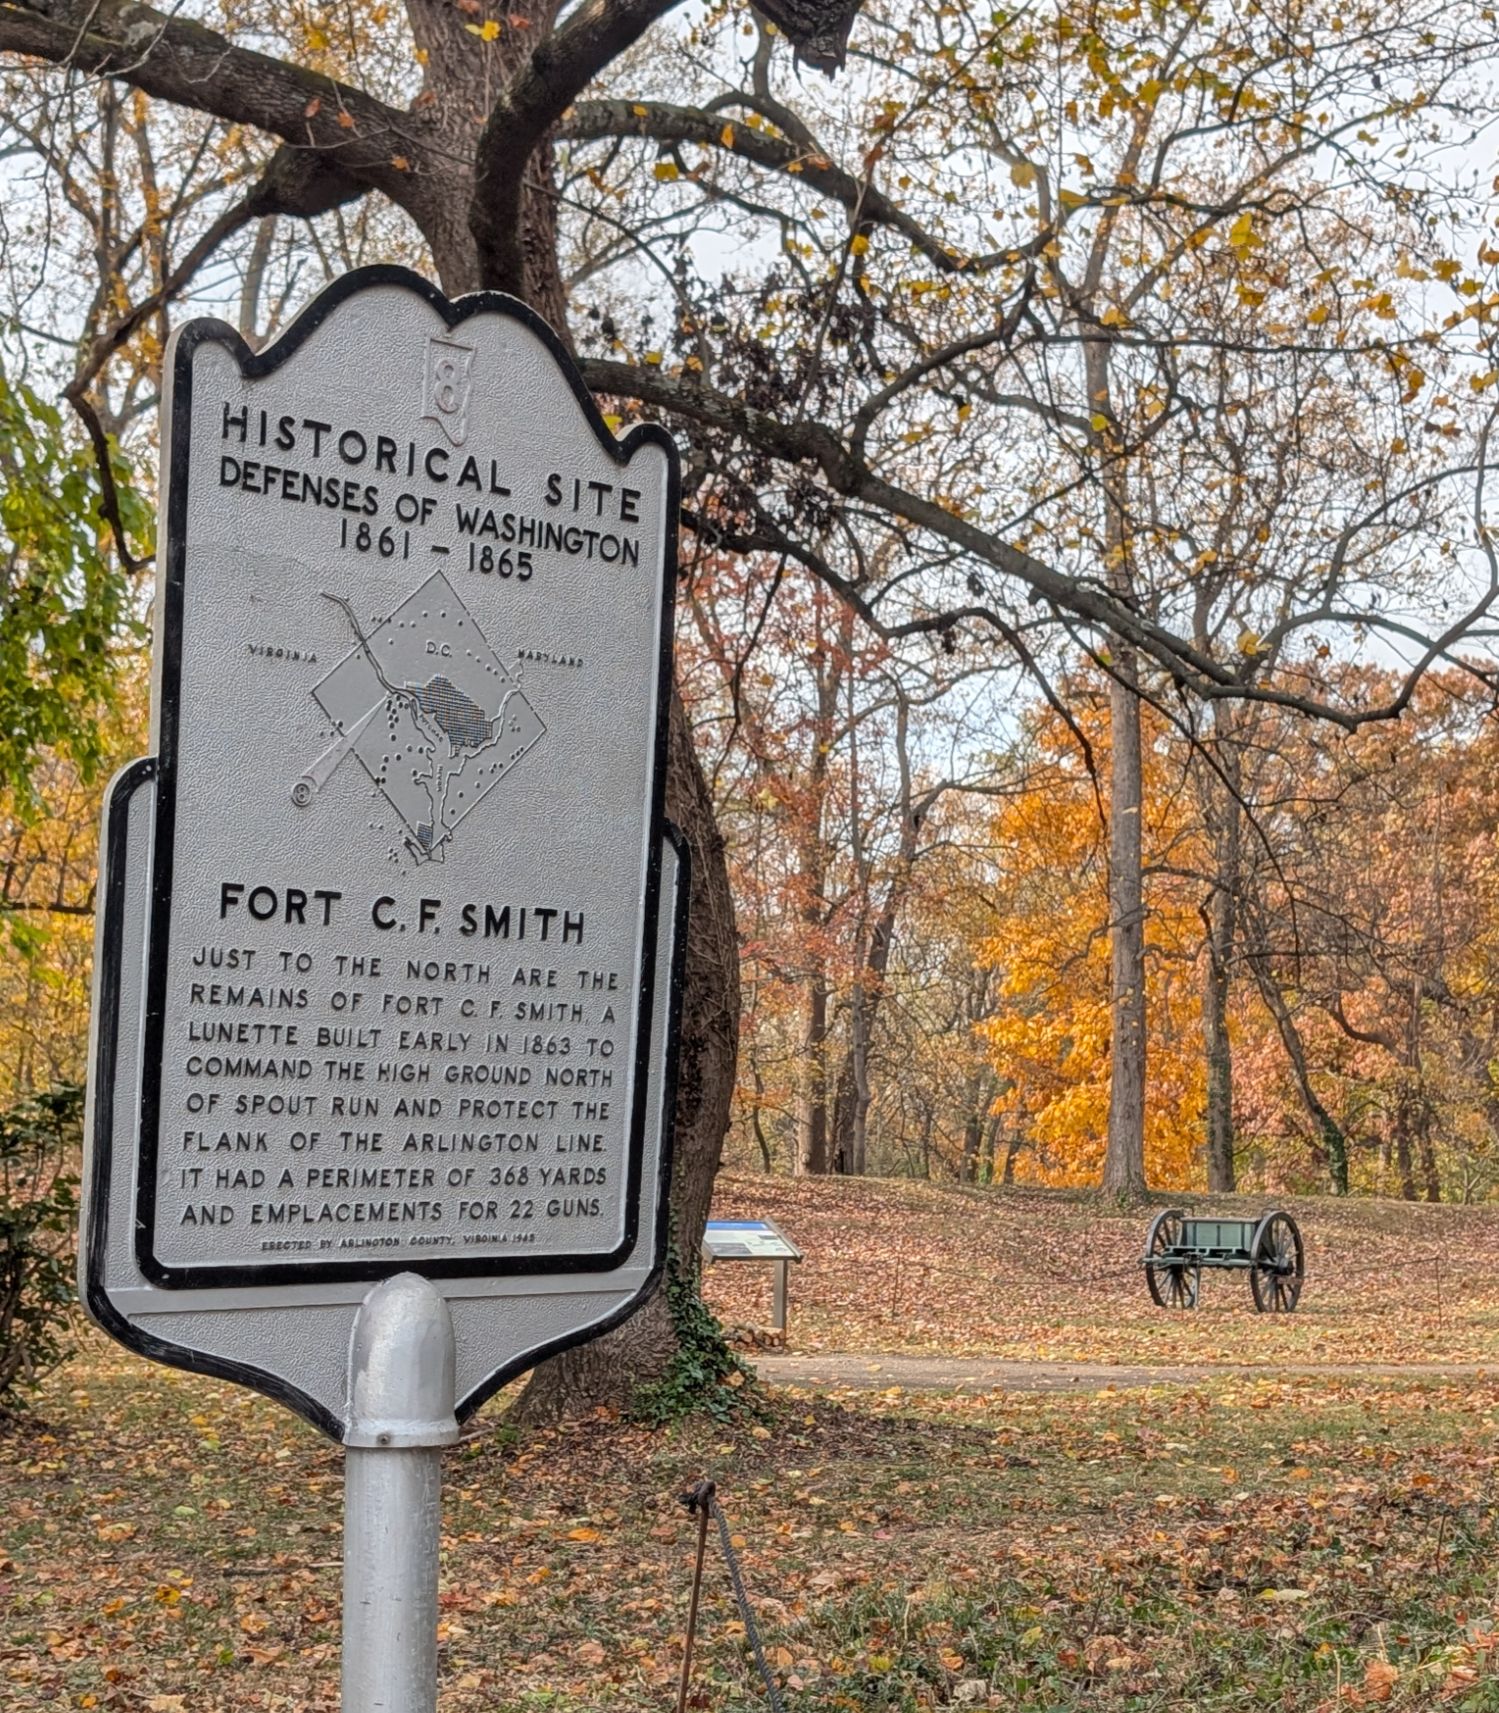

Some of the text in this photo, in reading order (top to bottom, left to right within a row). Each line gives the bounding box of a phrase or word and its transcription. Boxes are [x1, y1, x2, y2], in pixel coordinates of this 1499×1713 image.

[435, 360, 460, 413] 8
[222, 402, 641, 523] HISTORICAL SITE
[220, 456, 639, 566] DEFENSES OF WASHINGTON
[340, 518, 410, 559] 1861
[469, 543, 533, 581] 1865
[248, 644, 317, 662] VIRGINIA
[426, 641, 452, 658] D.C.
[518, 649, 583, 668] MARYLAND
[220, 883, 342, 926] FORT
[460, 904, 585, 944] SMITH
[193, 947, 618, 991] JUST TO THE NORTH ARE THE
[190, 983, 309, 1008] REMAINS
[331, 991, 363, 1012] OF
[382, 994, 444, 1015] FORT
[602, 1006, 616, 1024] A
[188, 1022, 615, 1057] LUNETTE BUILT EARLY IN 1863 TO
[186, 1057, 613, 1088] COMMAND THE HIGH GROUND NORTH
[186, 1093, 609, 1120] OF SPOUT RUN AND PROTECT THE
[183, 1131, 606, 1153] FLANK OF THE ARLINGTON LINE.
[180, 1167, 606, 1188] IT HAD A PERIMETER OF 368 YARDS
[180, 1199, 604, 1226] AND EMPLACEMENTS FOR 22 GUNS.
[262, 1240, 312, 1251] ERECTED
[319, 1239, 332, 1249] BY
[340, 1237, 400, 1248] ARLINGTON
[463, 1235, 507, 1244] VIRGINIA
